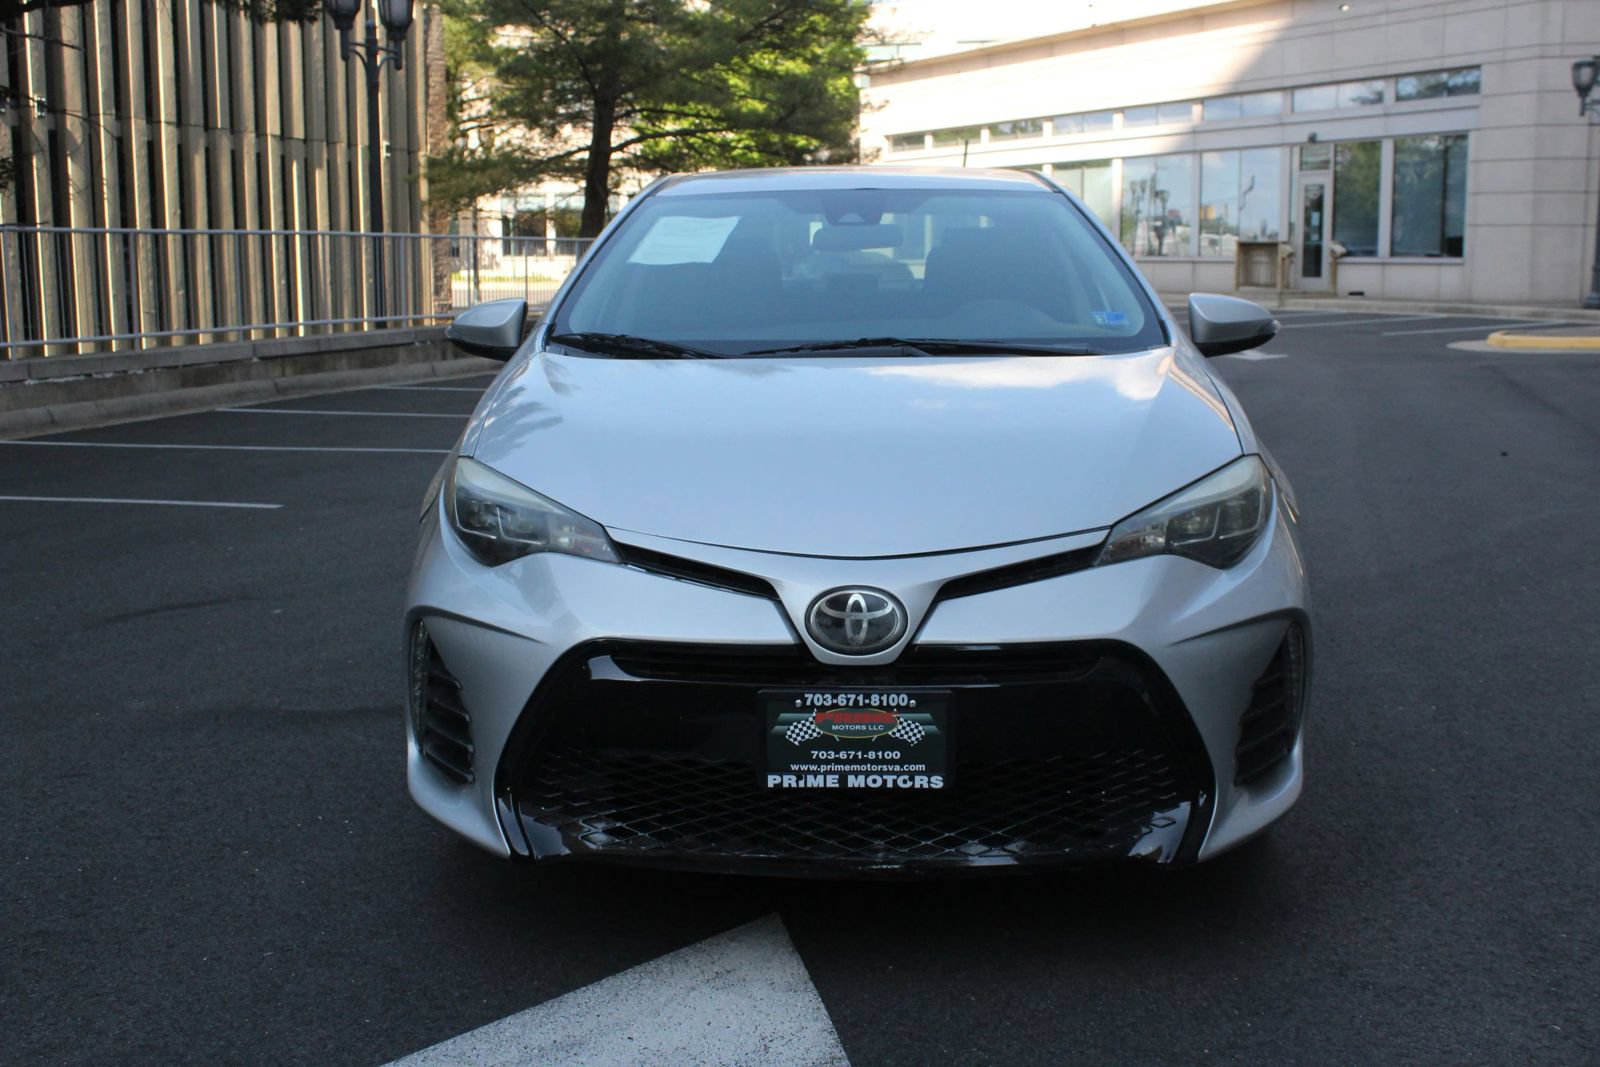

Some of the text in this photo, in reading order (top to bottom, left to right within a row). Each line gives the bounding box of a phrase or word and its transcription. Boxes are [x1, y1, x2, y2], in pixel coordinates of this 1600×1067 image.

[804, 693, 908, 706] 703-671-8100
[811, 750, 901, 760] 703-671-8100
[790, 762, 926, 773] www.primemotorsva.com
[847, 774, 944, 789] MOTORS
